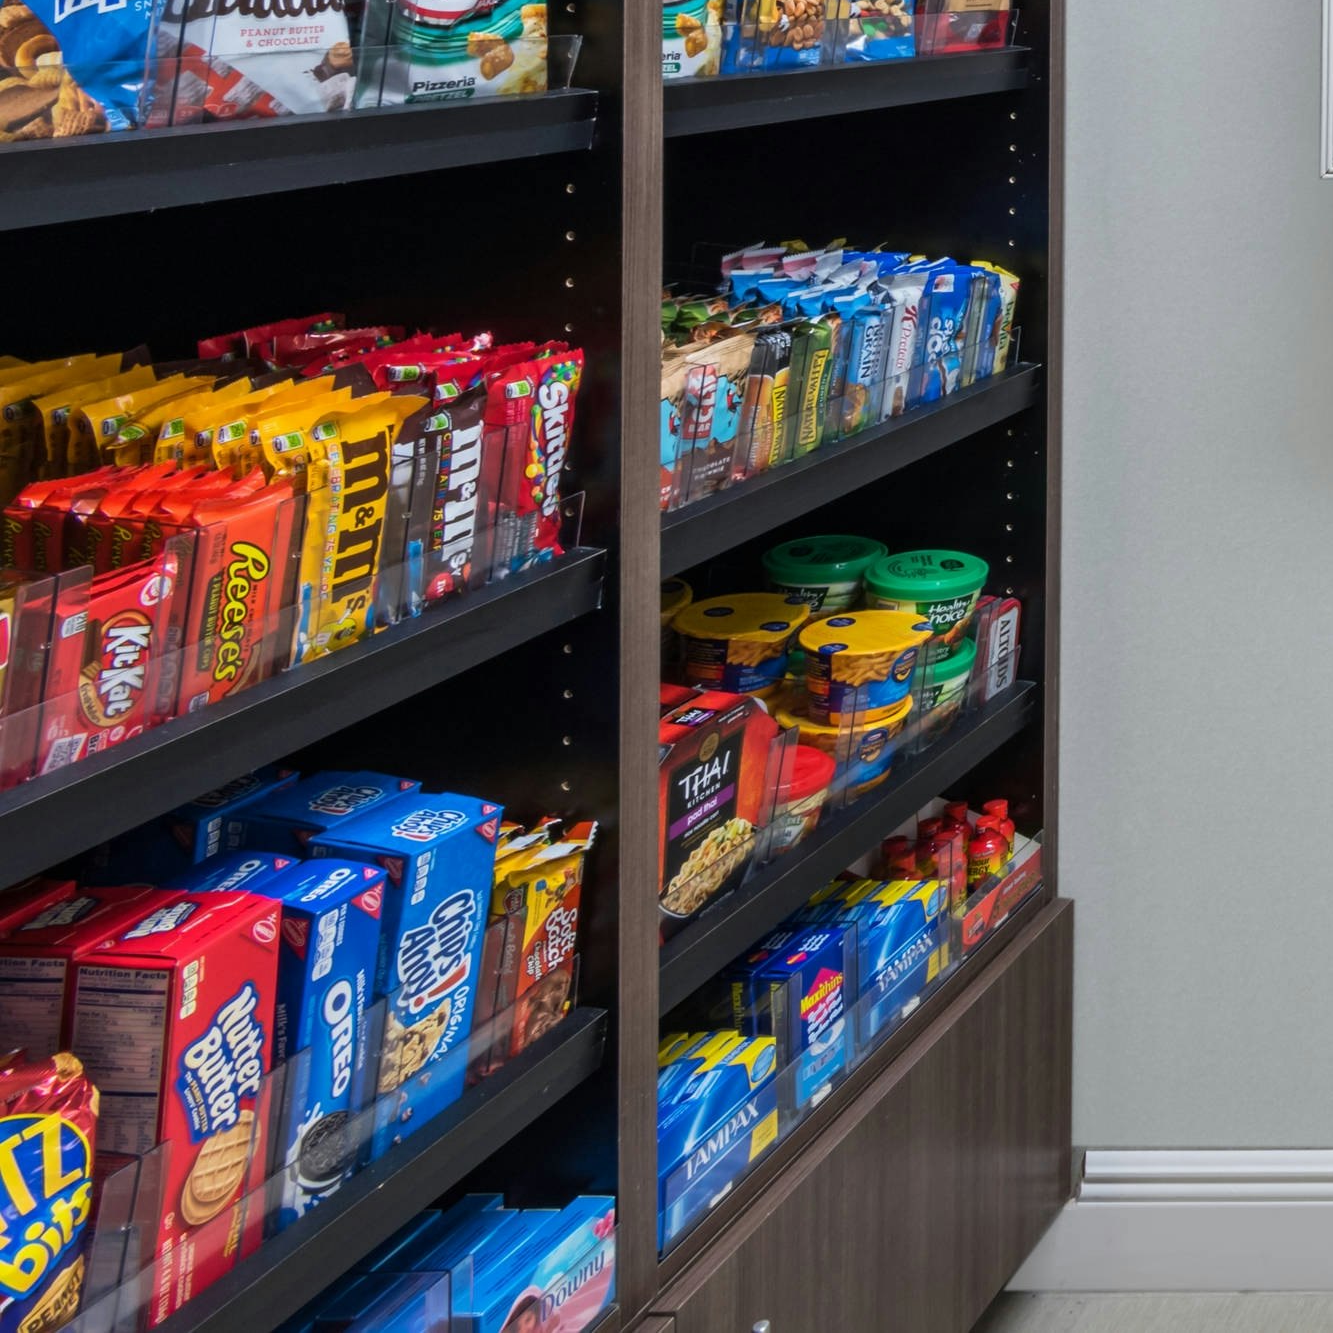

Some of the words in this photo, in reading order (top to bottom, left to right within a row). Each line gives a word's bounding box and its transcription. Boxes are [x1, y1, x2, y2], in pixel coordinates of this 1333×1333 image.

[240, 27, 283, 37] PEANUT
[287, 25, 325, 36] BUTTER
[245, 39, 253, 48] &
[258, 36, 321, 48] CHOCOLATE
[412, 76, 476, 93] Pizzeria
[537, 381, 569, 517] Skittles
[432, 508, 445, 522] 75
[213, 541, 271, 683] Reese's
[678, 750, 731, 800] THAI
[686, 782, 721, 810] KITCHEN
[687, 807, 703, 826] pad
[703, 796, 719, 816] thai
[300, 868, 351, 903] OREO
[431, 894, 474, 976] Chips
[875, 931, 934, 992] TAMPAX
[79, 968, 130, 978] Nutrition
[134, 970, 168, 980] Facts
[800, 971, 844, 1015] Maxithins
[216, 986, 263, 1097] Nutter
[324, 979, 353, 1098] OREO
[431, 985, 470, 1062] ORIGINAL
[184, 1026, 237, 1131] Butter
[0, 1112, 83, 1216] TZ
[685, 1098, 760, 1180] TAMPAX
[541, 1249, 606, 1323] Downy
